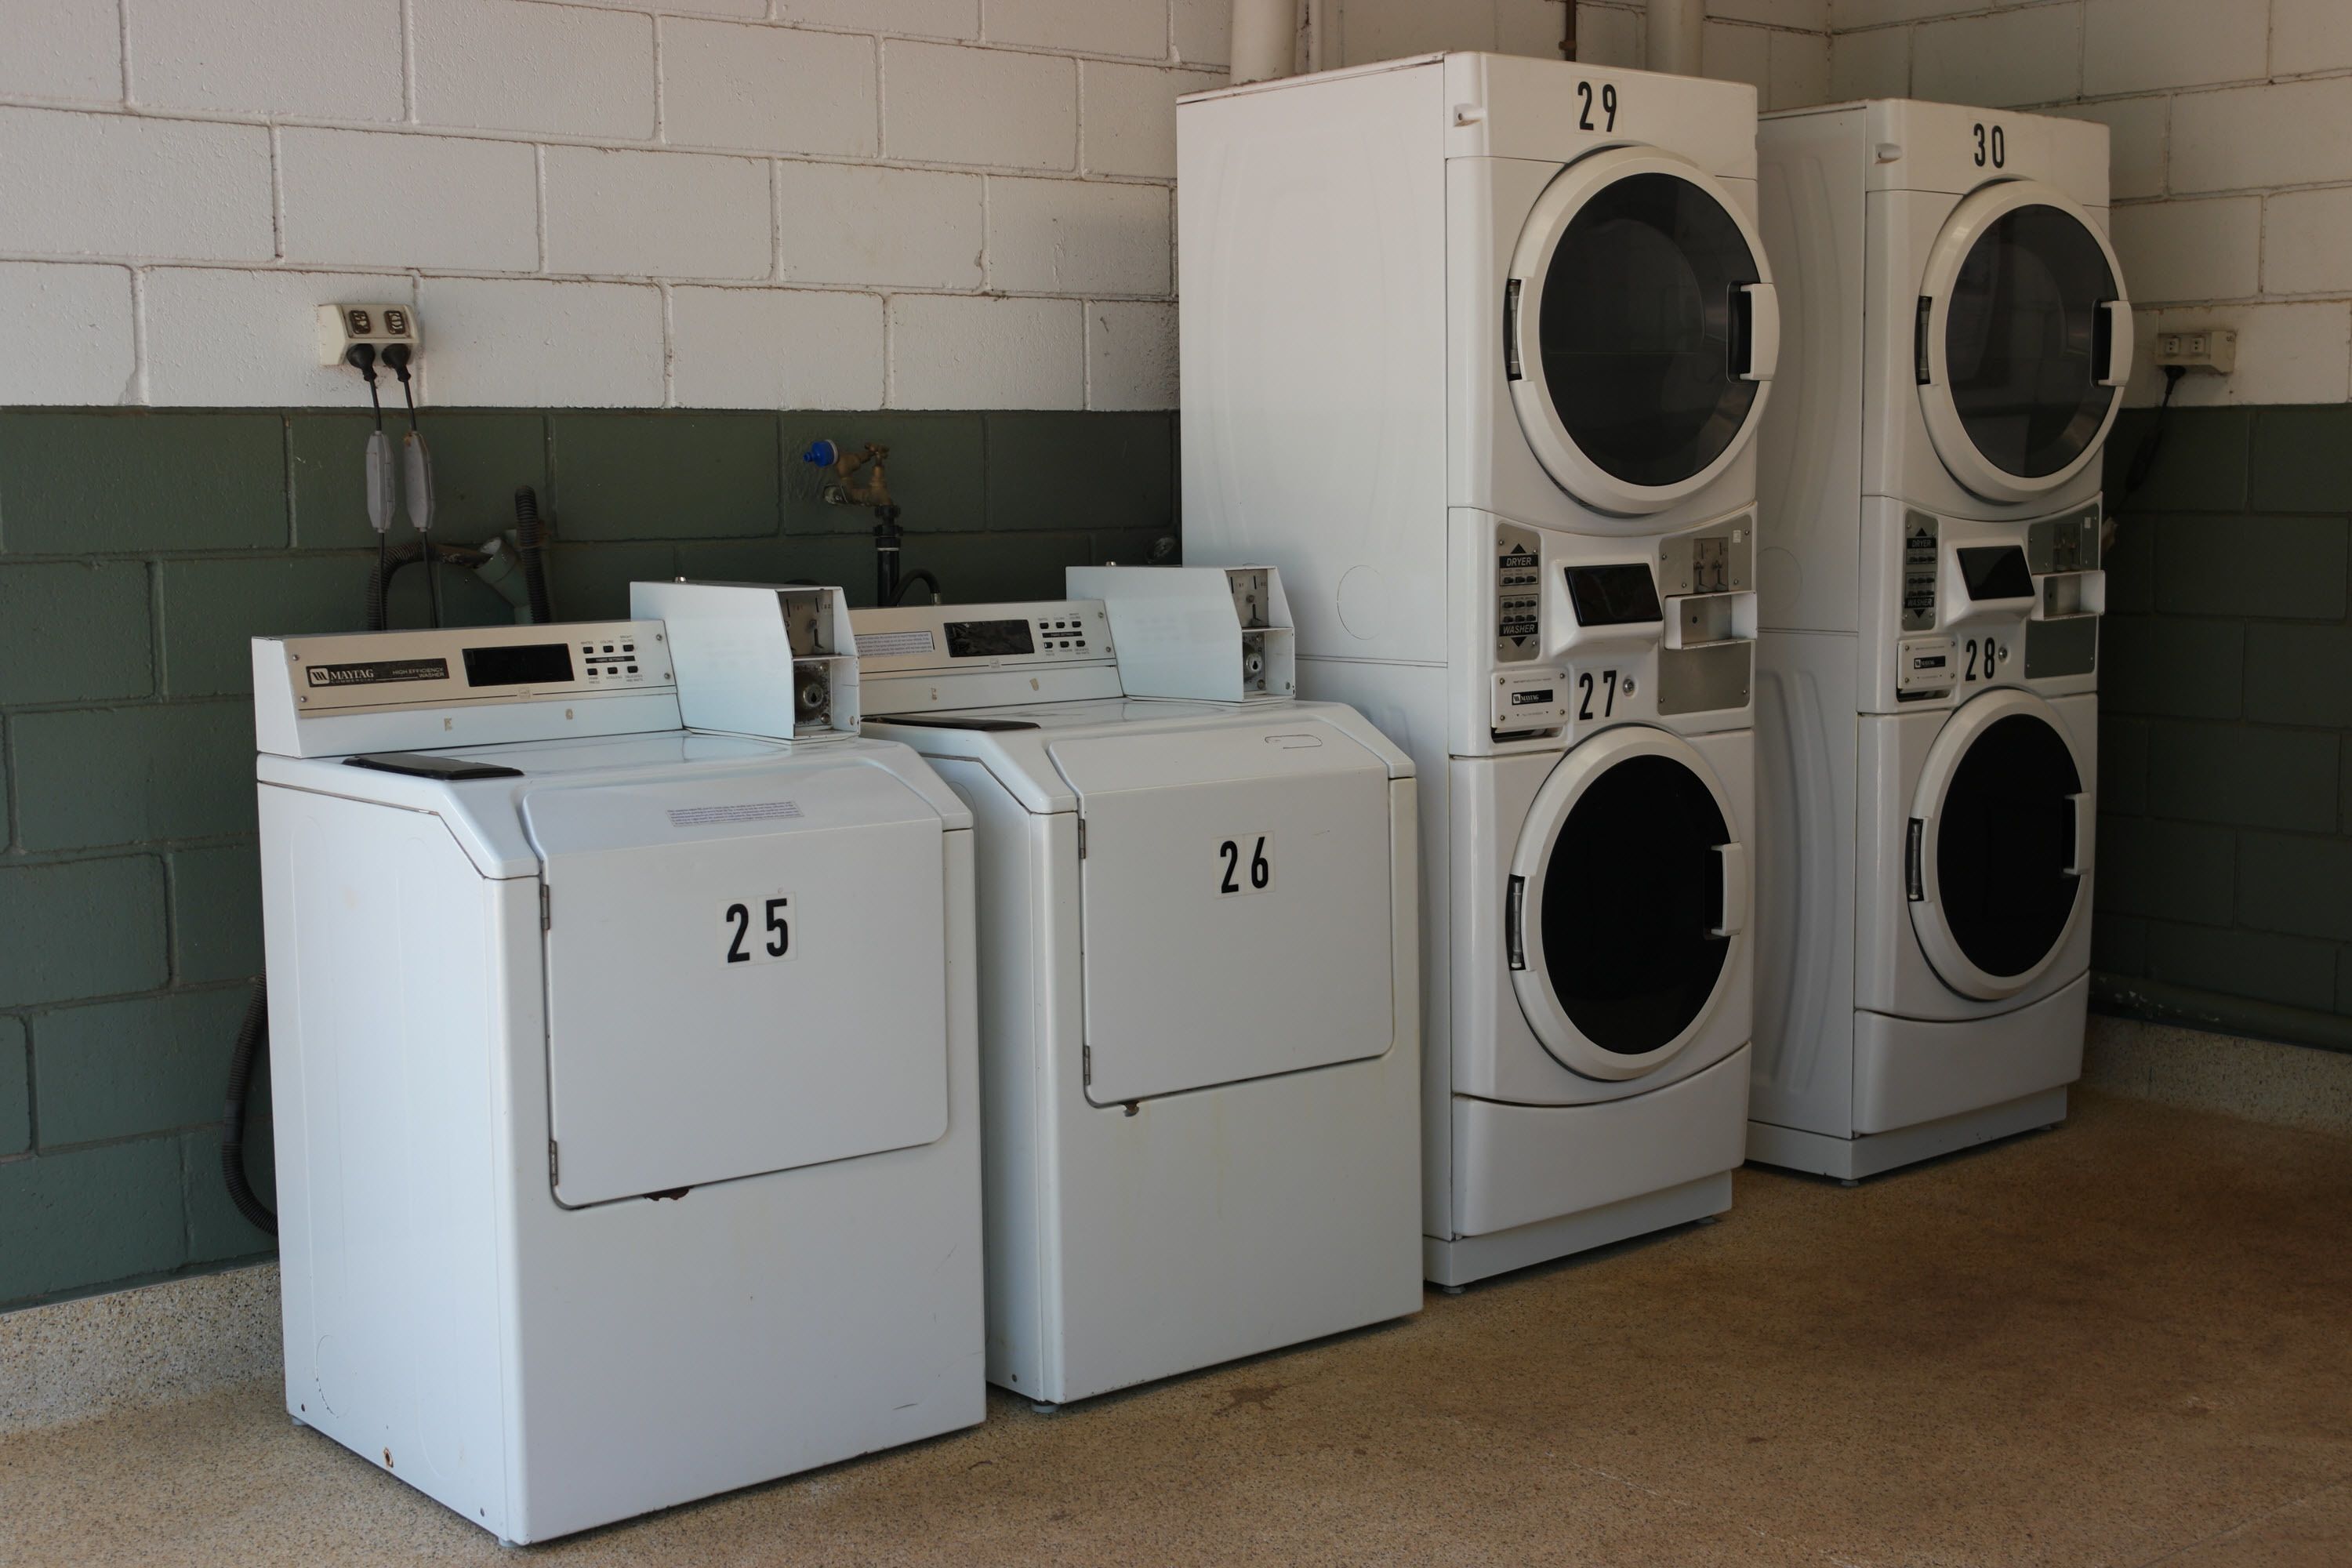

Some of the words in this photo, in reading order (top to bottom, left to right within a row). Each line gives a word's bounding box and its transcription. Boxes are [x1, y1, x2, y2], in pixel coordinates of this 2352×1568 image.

[1577, 81, 1617, 132] 29
[1973, 122, 2005, 169] 30
[1506, 557, 1532, 566] DRYER
[1503, 624, 1535, 634] WASHER
[330, 669, 374, 681] MAYTAG
[1965, 637, 1995, 682] 28
[1579, 670, 1617, 720] 27
[1220, 836, 1269, 894] 26
[726, 898, 789, 964] 25
